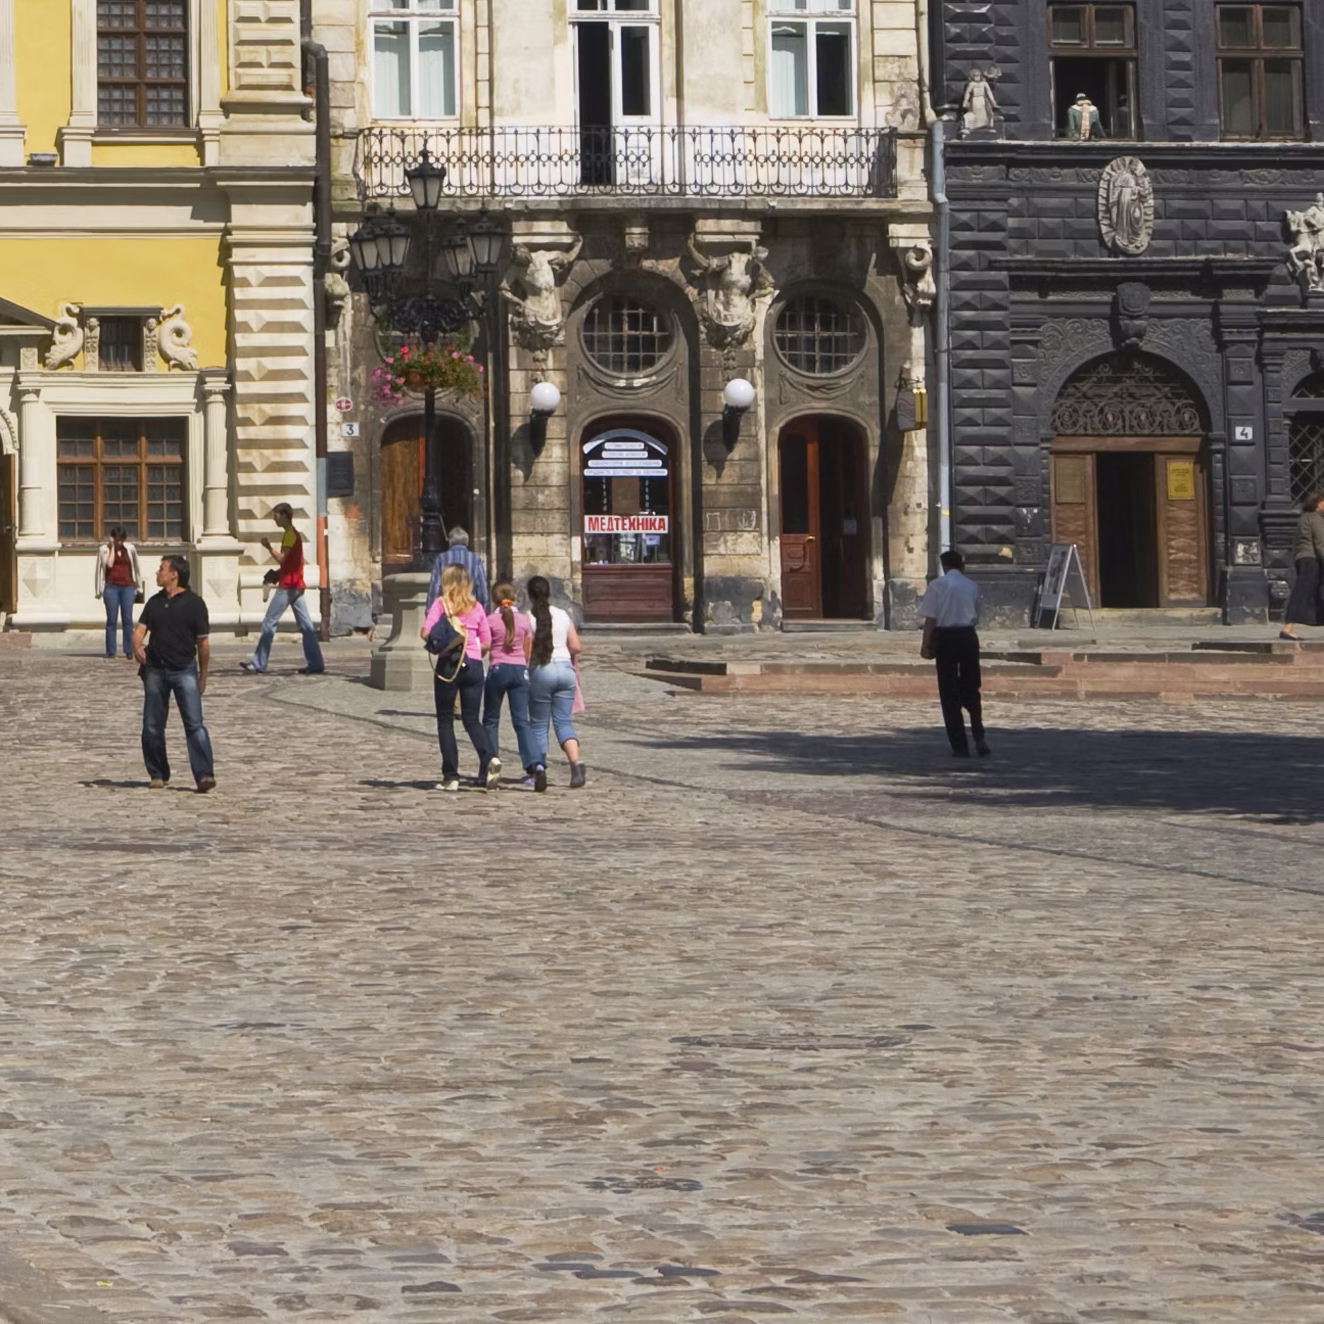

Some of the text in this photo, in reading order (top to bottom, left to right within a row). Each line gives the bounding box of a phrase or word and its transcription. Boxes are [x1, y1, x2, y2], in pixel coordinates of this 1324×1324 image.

[346, 423, 354, 436] 3
[1240, 427, 1249, 439] 4
[588, 517, 666, 531] МЕДТЕХНІКА
